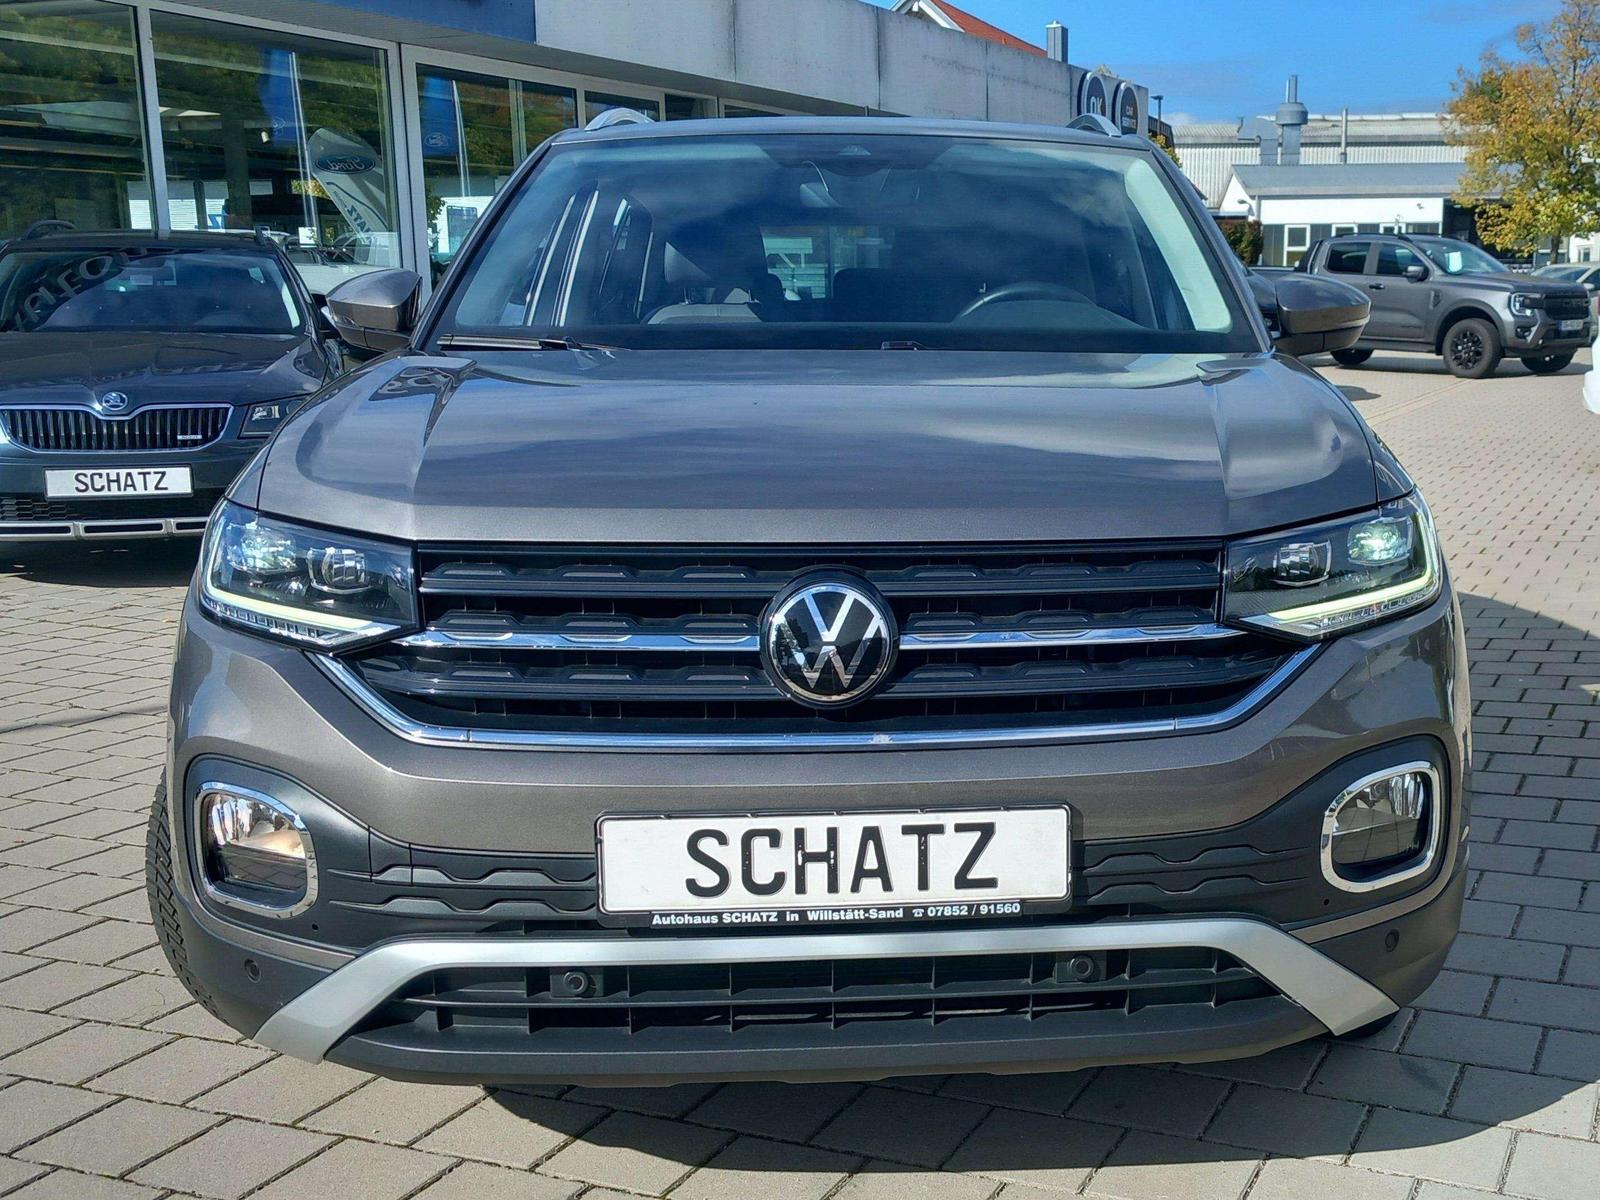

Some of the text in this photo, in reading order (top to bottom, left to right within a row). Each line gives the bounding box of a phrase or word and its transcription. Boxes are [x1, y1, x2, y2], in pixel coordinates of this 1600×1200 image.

[74, 471, 169, 493] SCHATZ
[684, 822, 999, 898] SCHATZ
[652, 913, 719, 925] Autohaus
[722, 912, 778, 924] SCHATZ
[786, 911, 800, 922] in
[806, 908, 904, 921] Willstätt-Sand
[927, 904, 969, 917] 07852
[979, 902, 1021, 915] 91560
